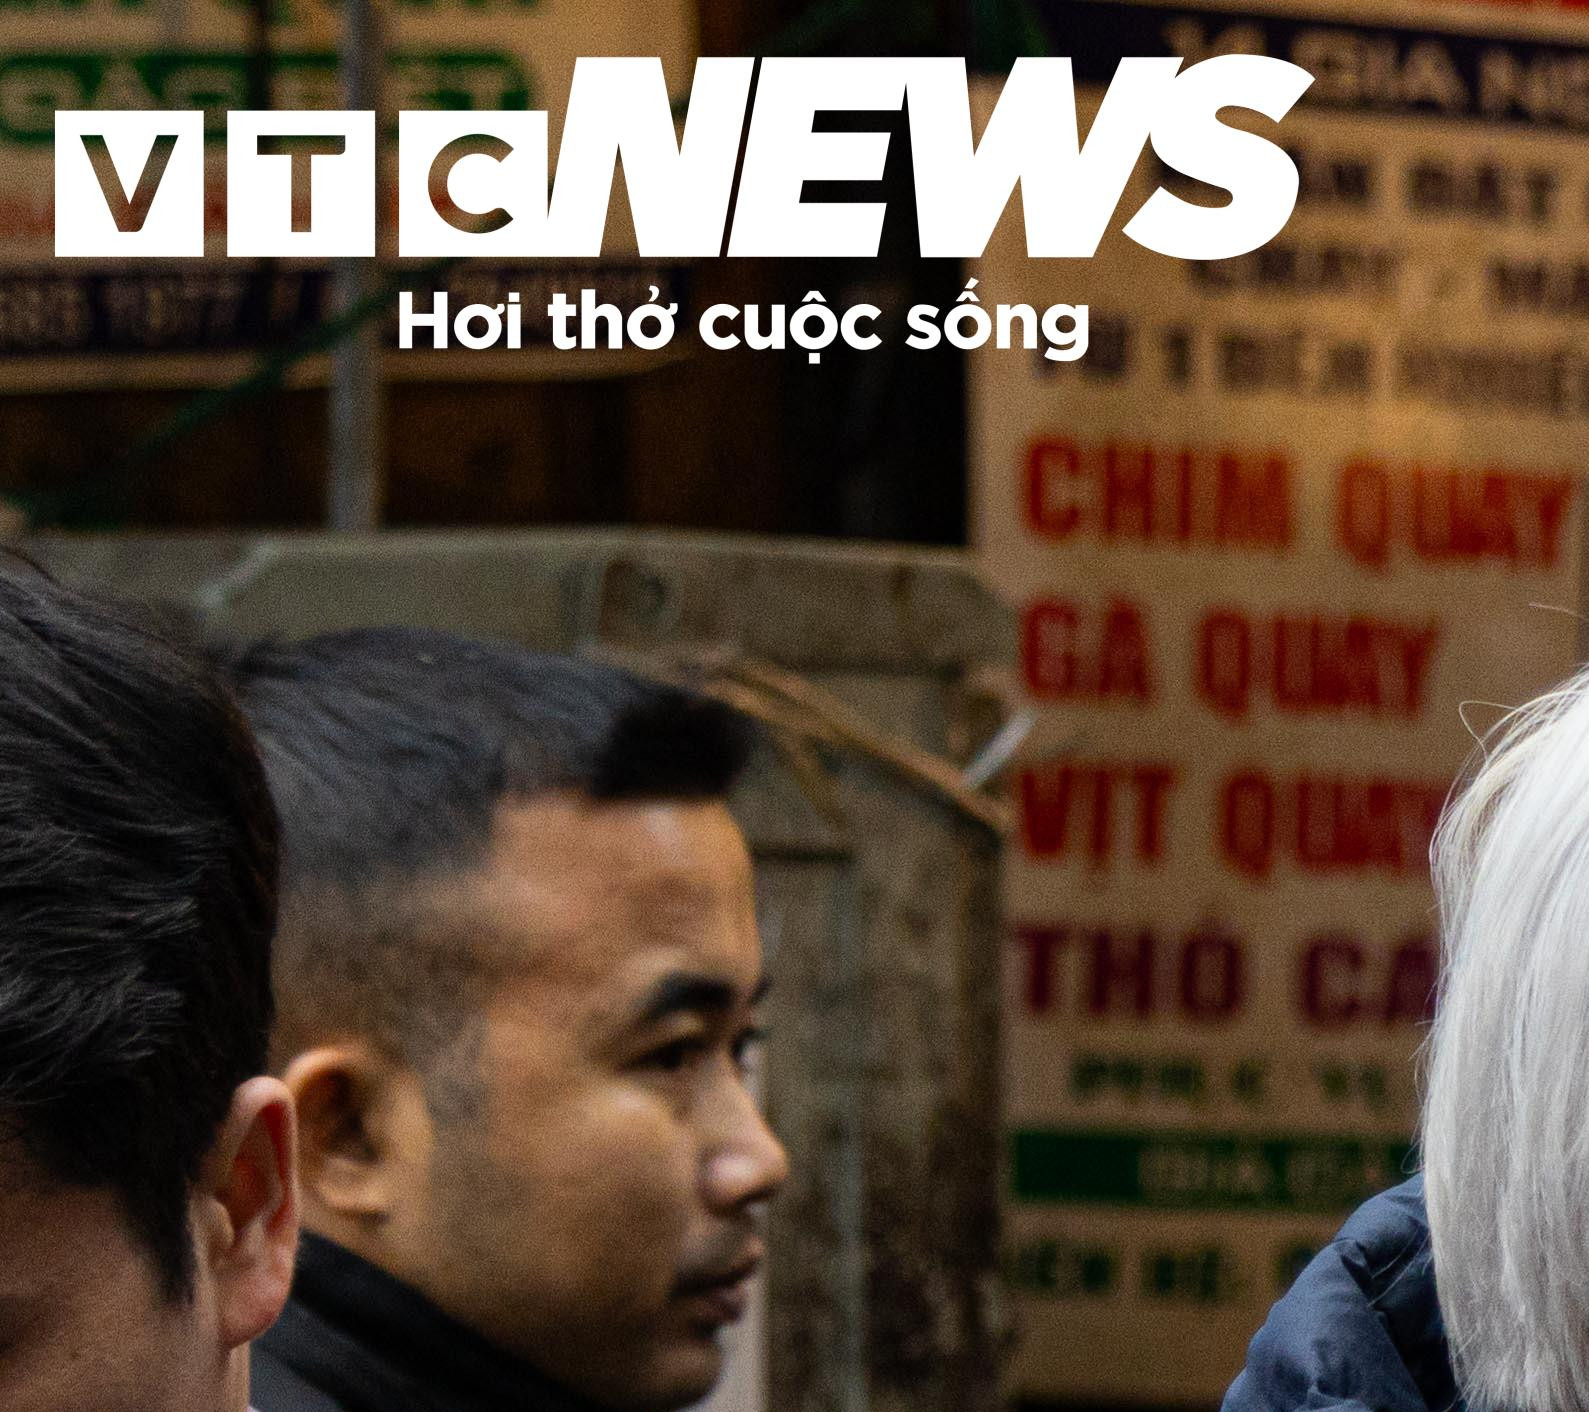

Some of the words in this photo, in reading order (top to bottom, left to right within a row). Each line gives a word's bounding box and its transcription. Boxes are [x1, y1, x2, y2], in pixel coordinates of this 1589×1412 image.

[1020, 434, 1298, 552] CHIM
[1334, 454, 1580, 574] QUAY
[1198, 609, 1442, 720] QUAY
